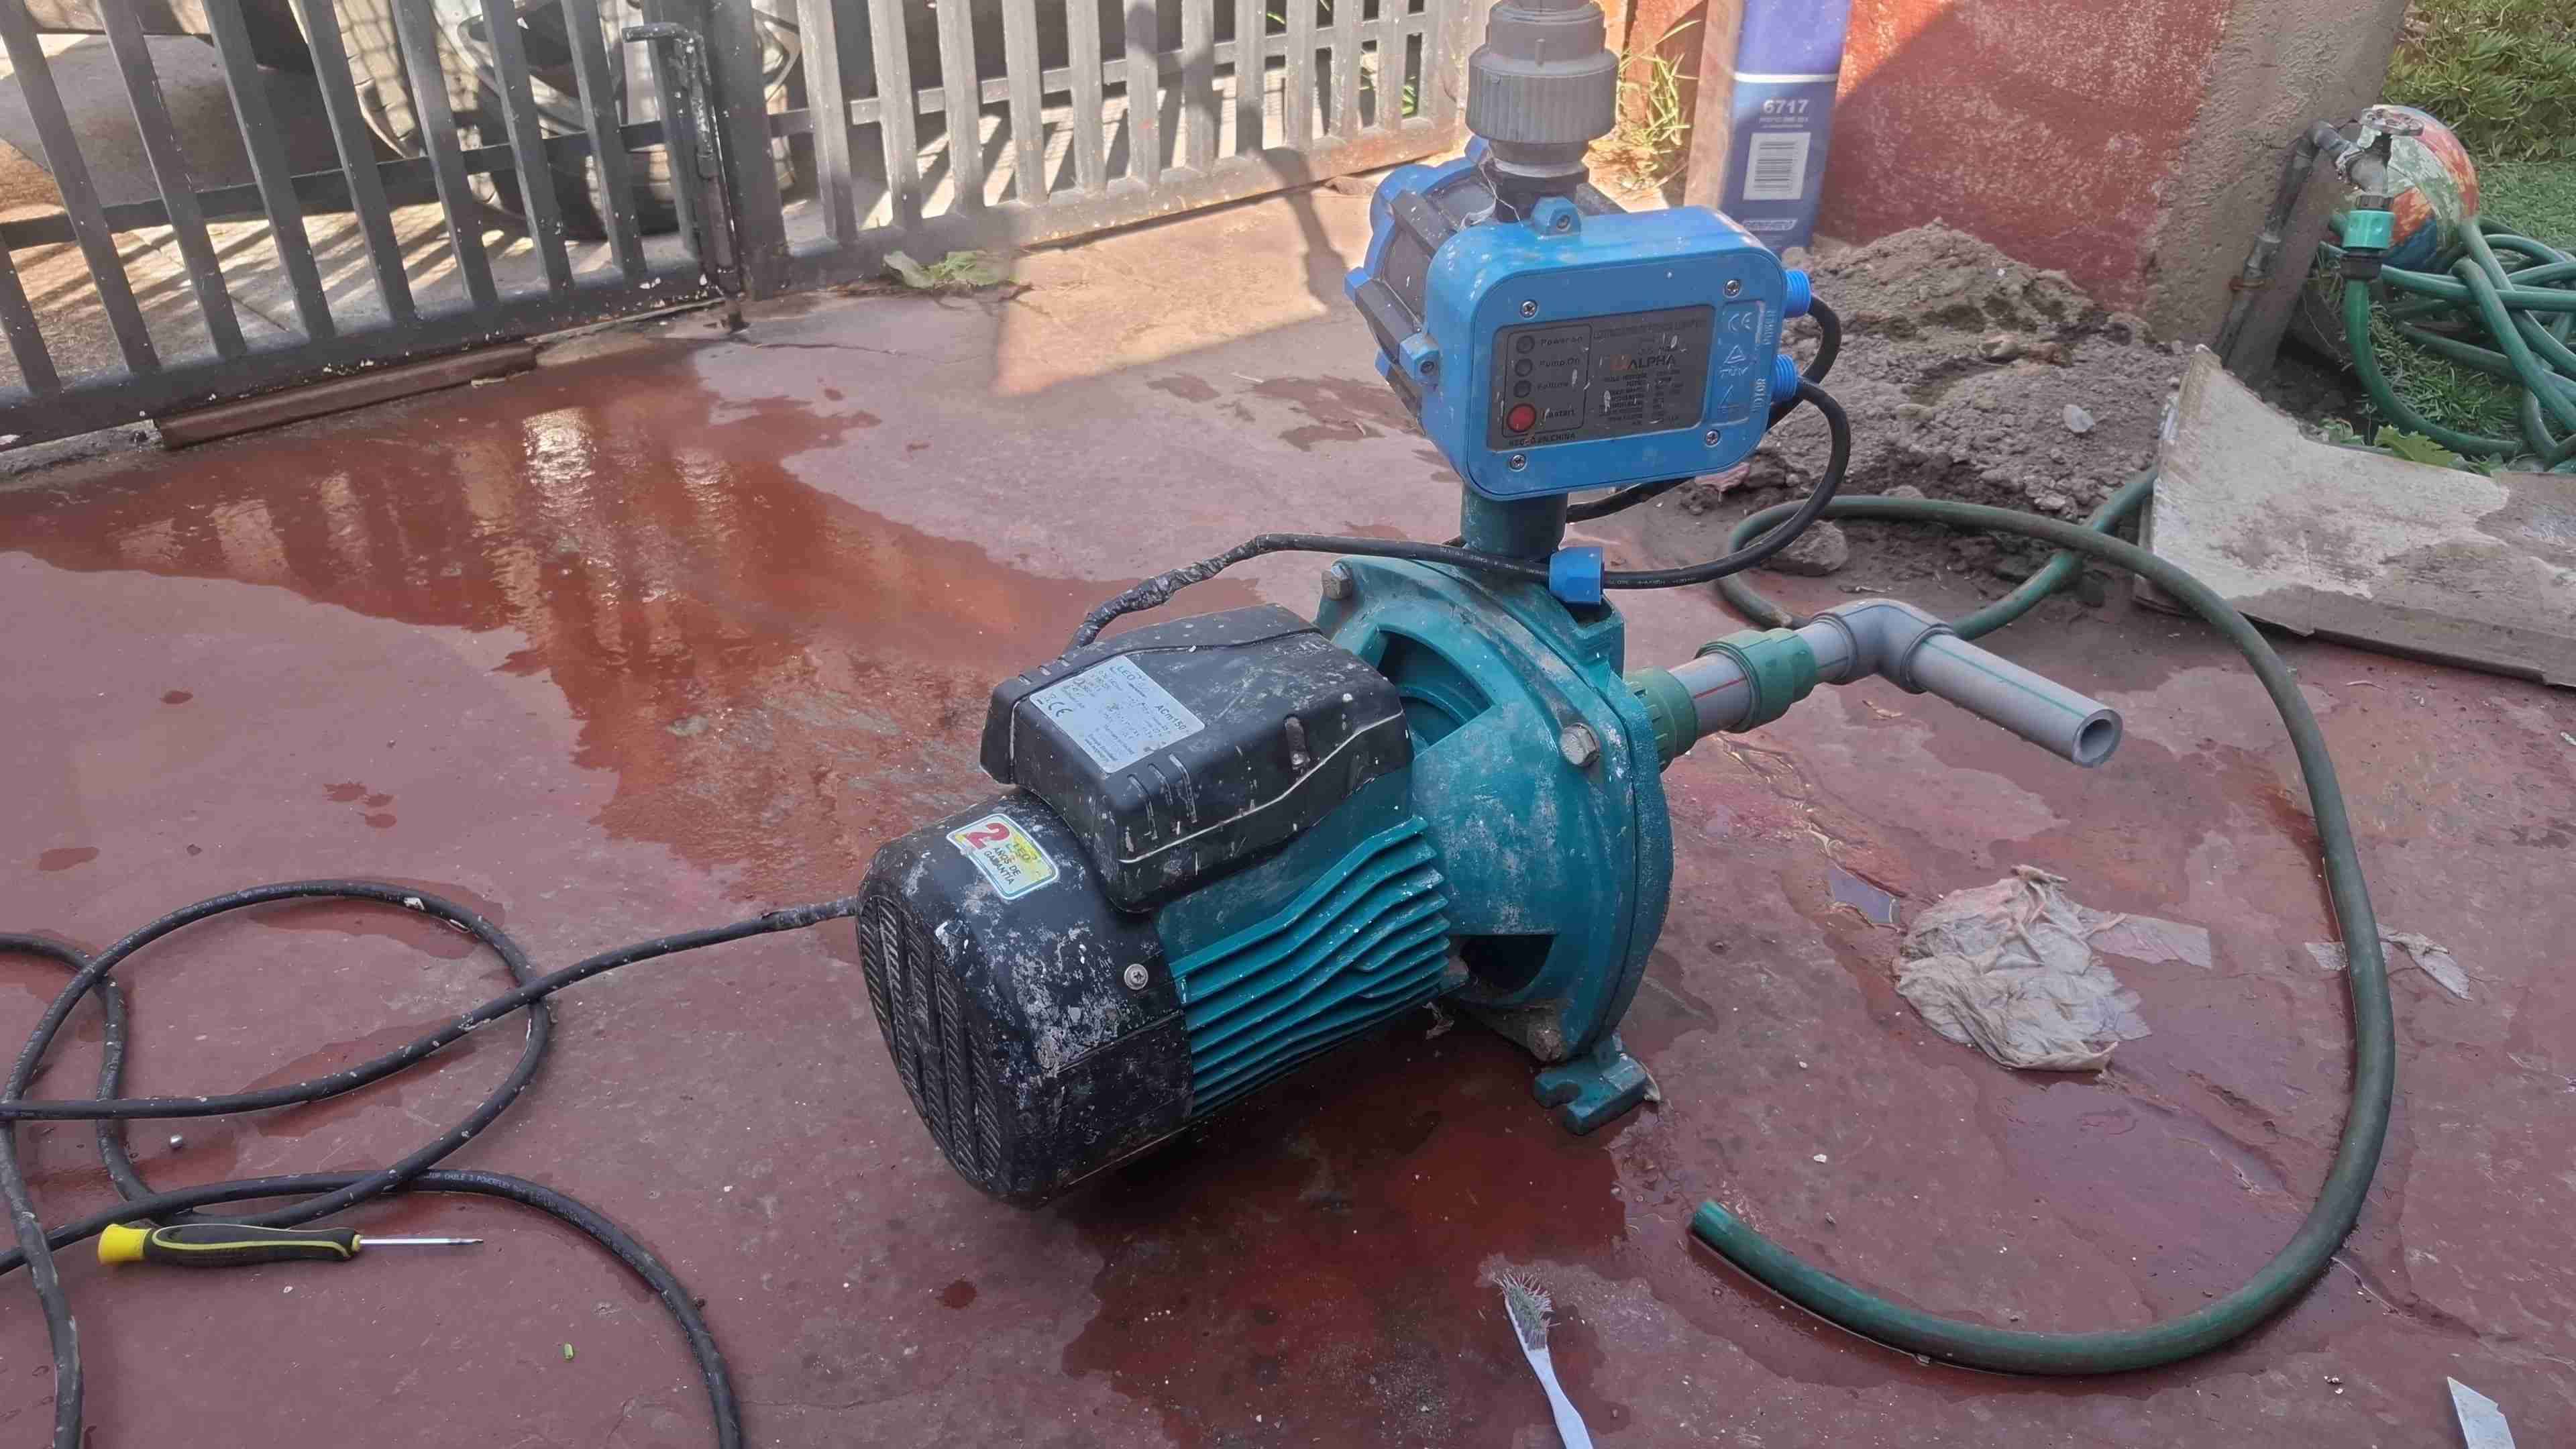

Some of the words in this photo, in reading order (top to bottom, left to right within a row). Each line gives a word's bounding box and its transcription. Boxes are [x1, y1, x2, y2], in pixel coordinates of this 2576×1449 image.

[1763, 99, 1809, 114] 6717
[1540, 337, 1569, 346] Power
[1540, 359, 1566, 368] Pump
[1627, 354, 1676, 370] ALPHA
[1549, 431, 1576, 443] CHINA
[965, 822, 1011, 850] 2
[1008, 865, 1022, 877] DE
